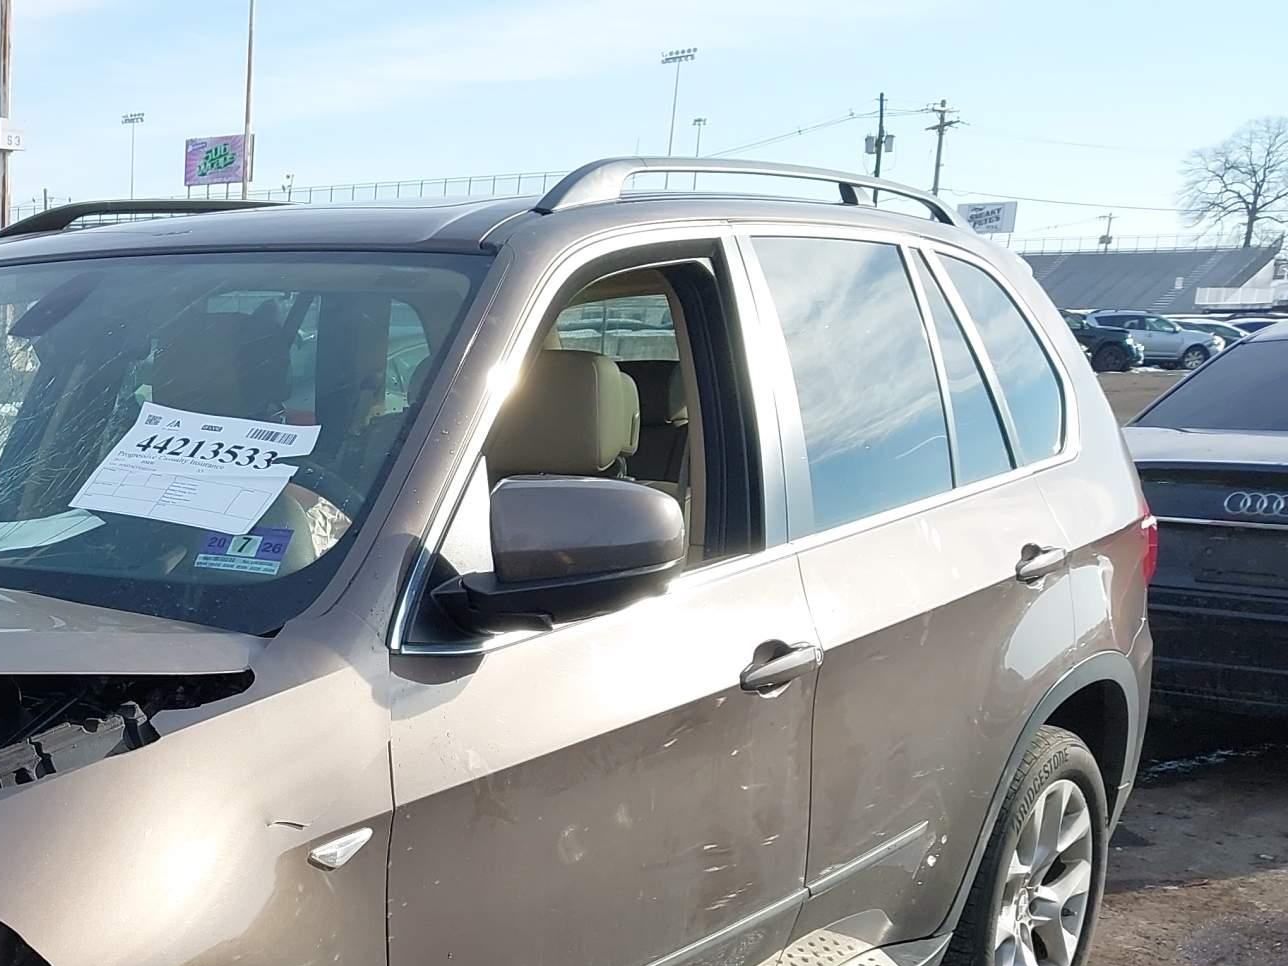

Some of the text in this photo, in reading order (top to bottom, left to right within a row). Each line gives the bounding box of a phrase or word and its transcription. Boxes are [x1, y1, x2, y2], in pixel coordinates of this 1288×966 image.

[117, 450, 158, 461] Progressive
[189, 457, 225, 470] Insurance
[136, 434, 279, 470] 44213533
[207, 536, 283, 554] 20 7 26
